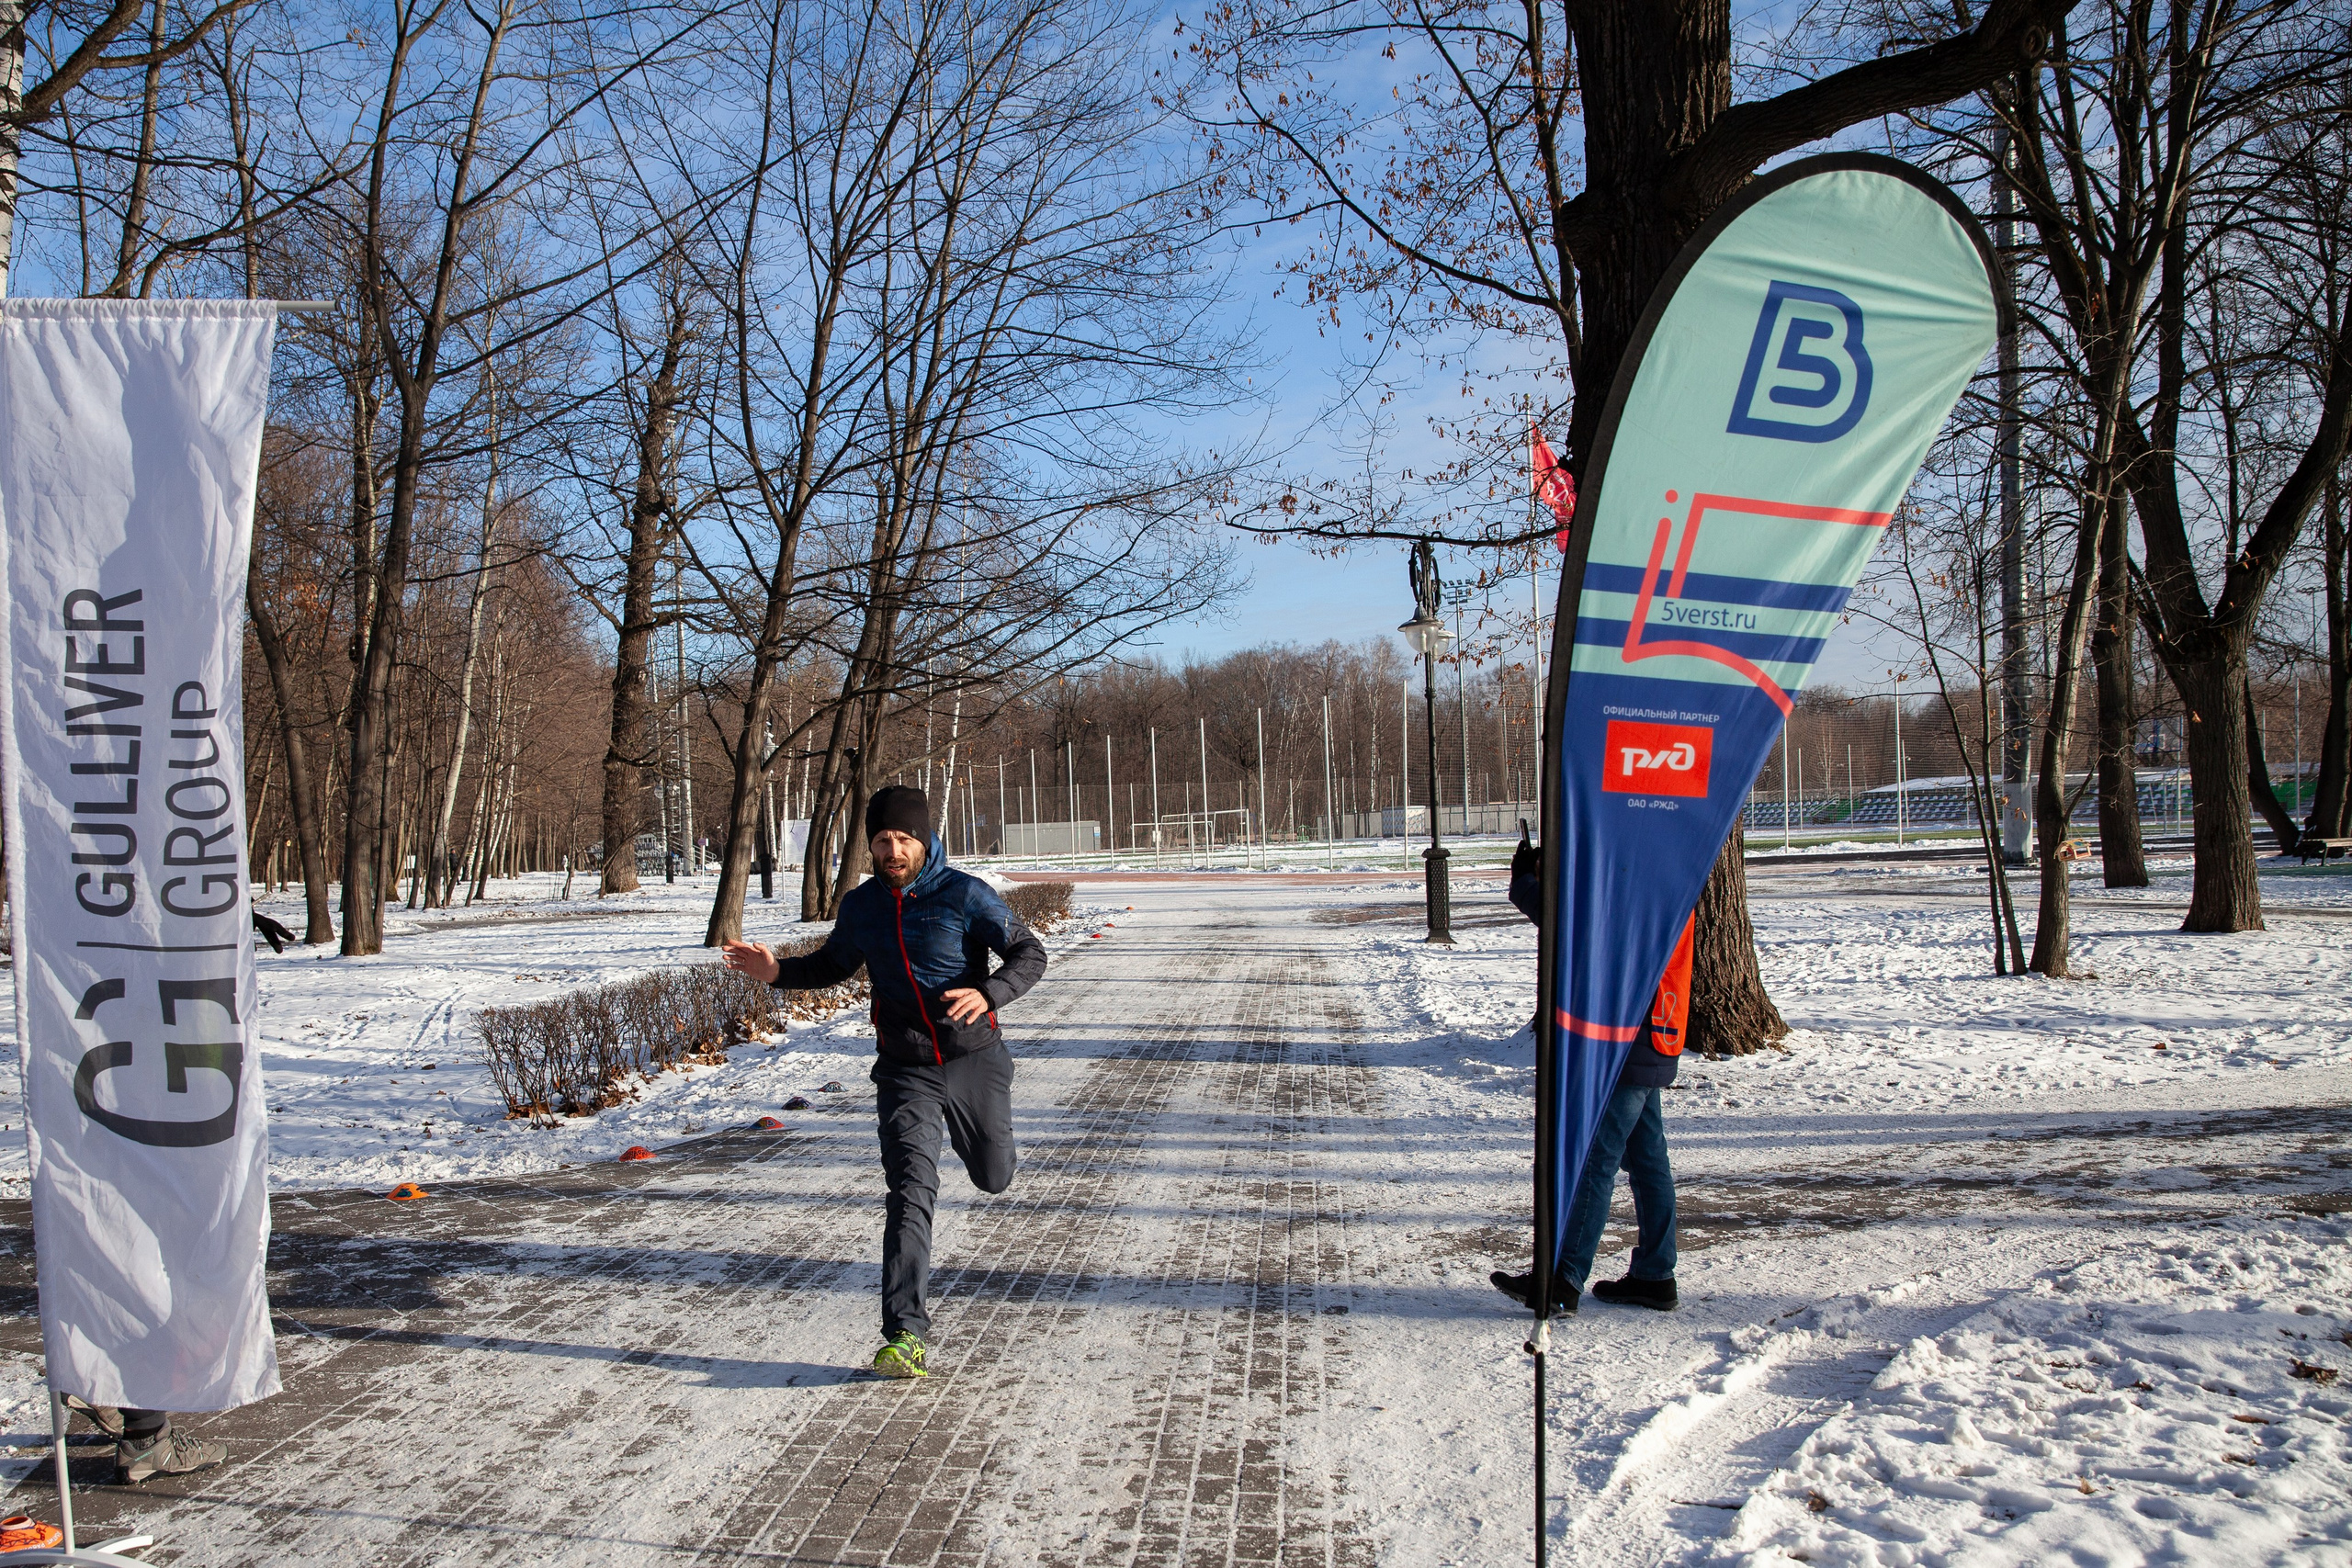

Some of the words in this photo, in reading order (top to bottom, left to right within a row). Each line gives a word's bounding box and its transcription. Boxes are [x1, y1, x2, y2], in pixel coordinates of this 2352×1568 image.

[1661, 601, 1757, 630] 5verst.ru
[1602, 705, 1678, 720] ОФИЦИАЛЬНЫЙ
[1679, 711, 1720, 723] ПАРТНЕР
[63, 588, 145, 917] GULLIVER
[160, 680, 239, 918] GROUP
[1627, 798, 1646, 808] ОАО
[1648, 799, 1679, 811] «РЖД»
